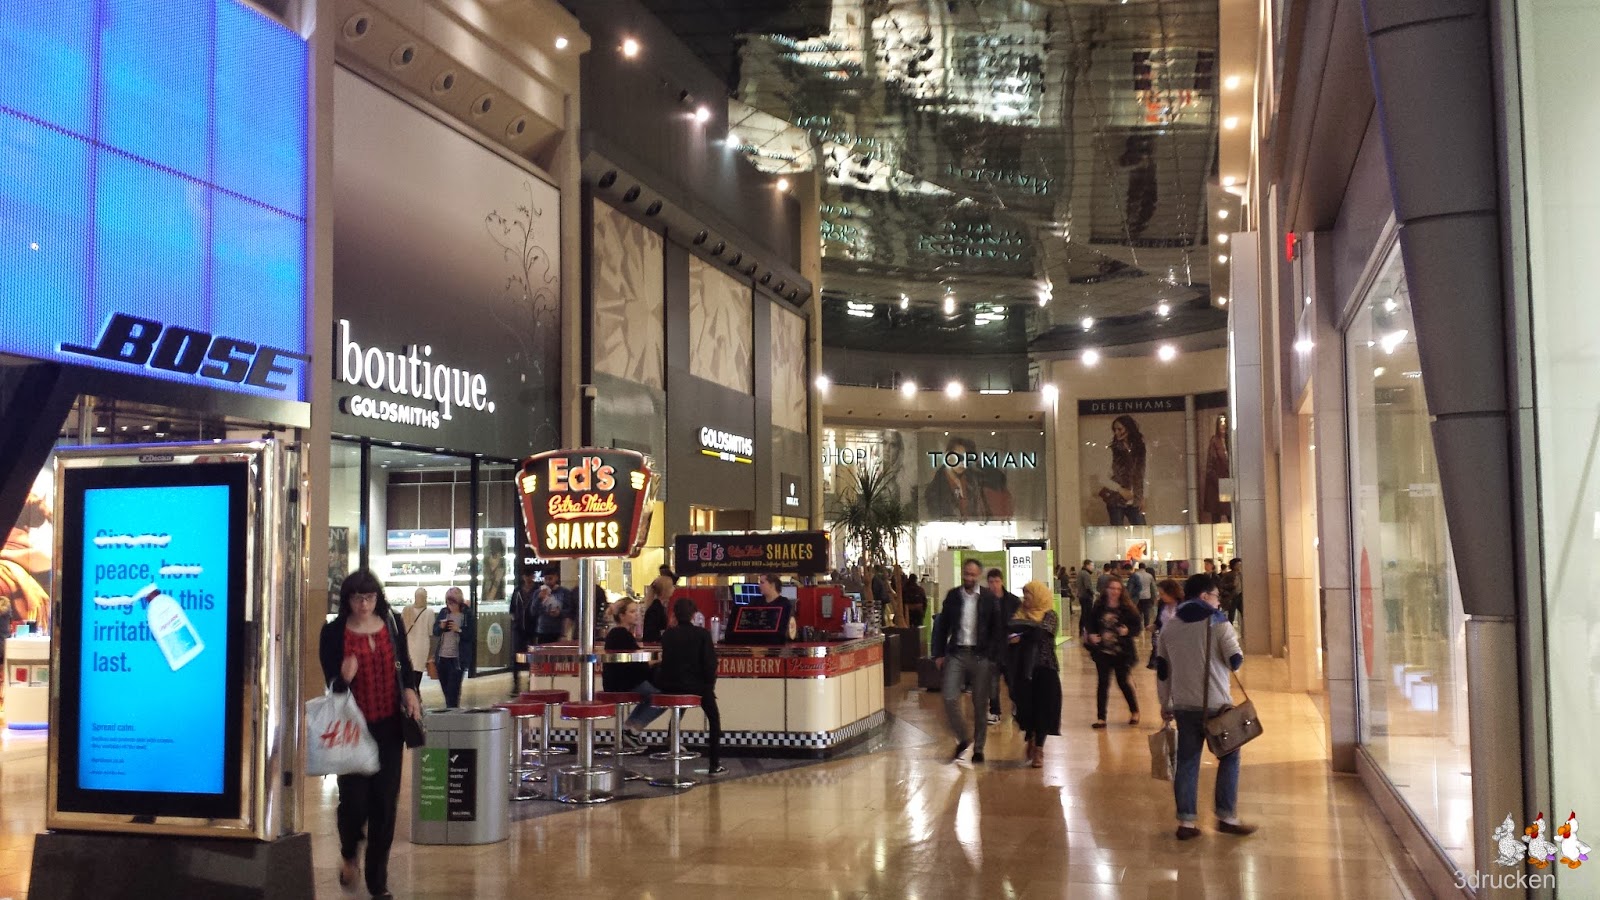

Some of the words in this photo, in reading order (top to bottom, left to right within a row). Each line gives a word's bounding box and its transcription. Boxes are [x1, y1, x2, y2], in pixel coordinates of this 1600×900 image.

[61, 311, 311, 391] BOSE
[340, 319, 495, 421] boutique.
[351, 395, 440, 429] GOLDSMITHS
[1091, 401, 1172, 412] DEBENHAMS
[701, 426, 753, 457] GOLDSMITHS
[927, 451, 1038, 469] TOPMAN
[548, 456, 616, 492] Ed's
[548, 494, 582, 517] Extra
[581, 493, 618, 514] Thick
[545, 521, 620, 550] SHAKES
[688, 542, 724, 561] Ed's
[766, 543, 813, 560] SHAKES
[1012, 556, 1031, 565] BAR
[95, 562, 155, 585] peace,
[179, 589, 214, 611] this
[93, 620, 157, 642] irritati
[93, 651, 132, 673] last.
[717, 658, 782, 674] TRAWBERRY
[92, 723, 116, 732] Spread
